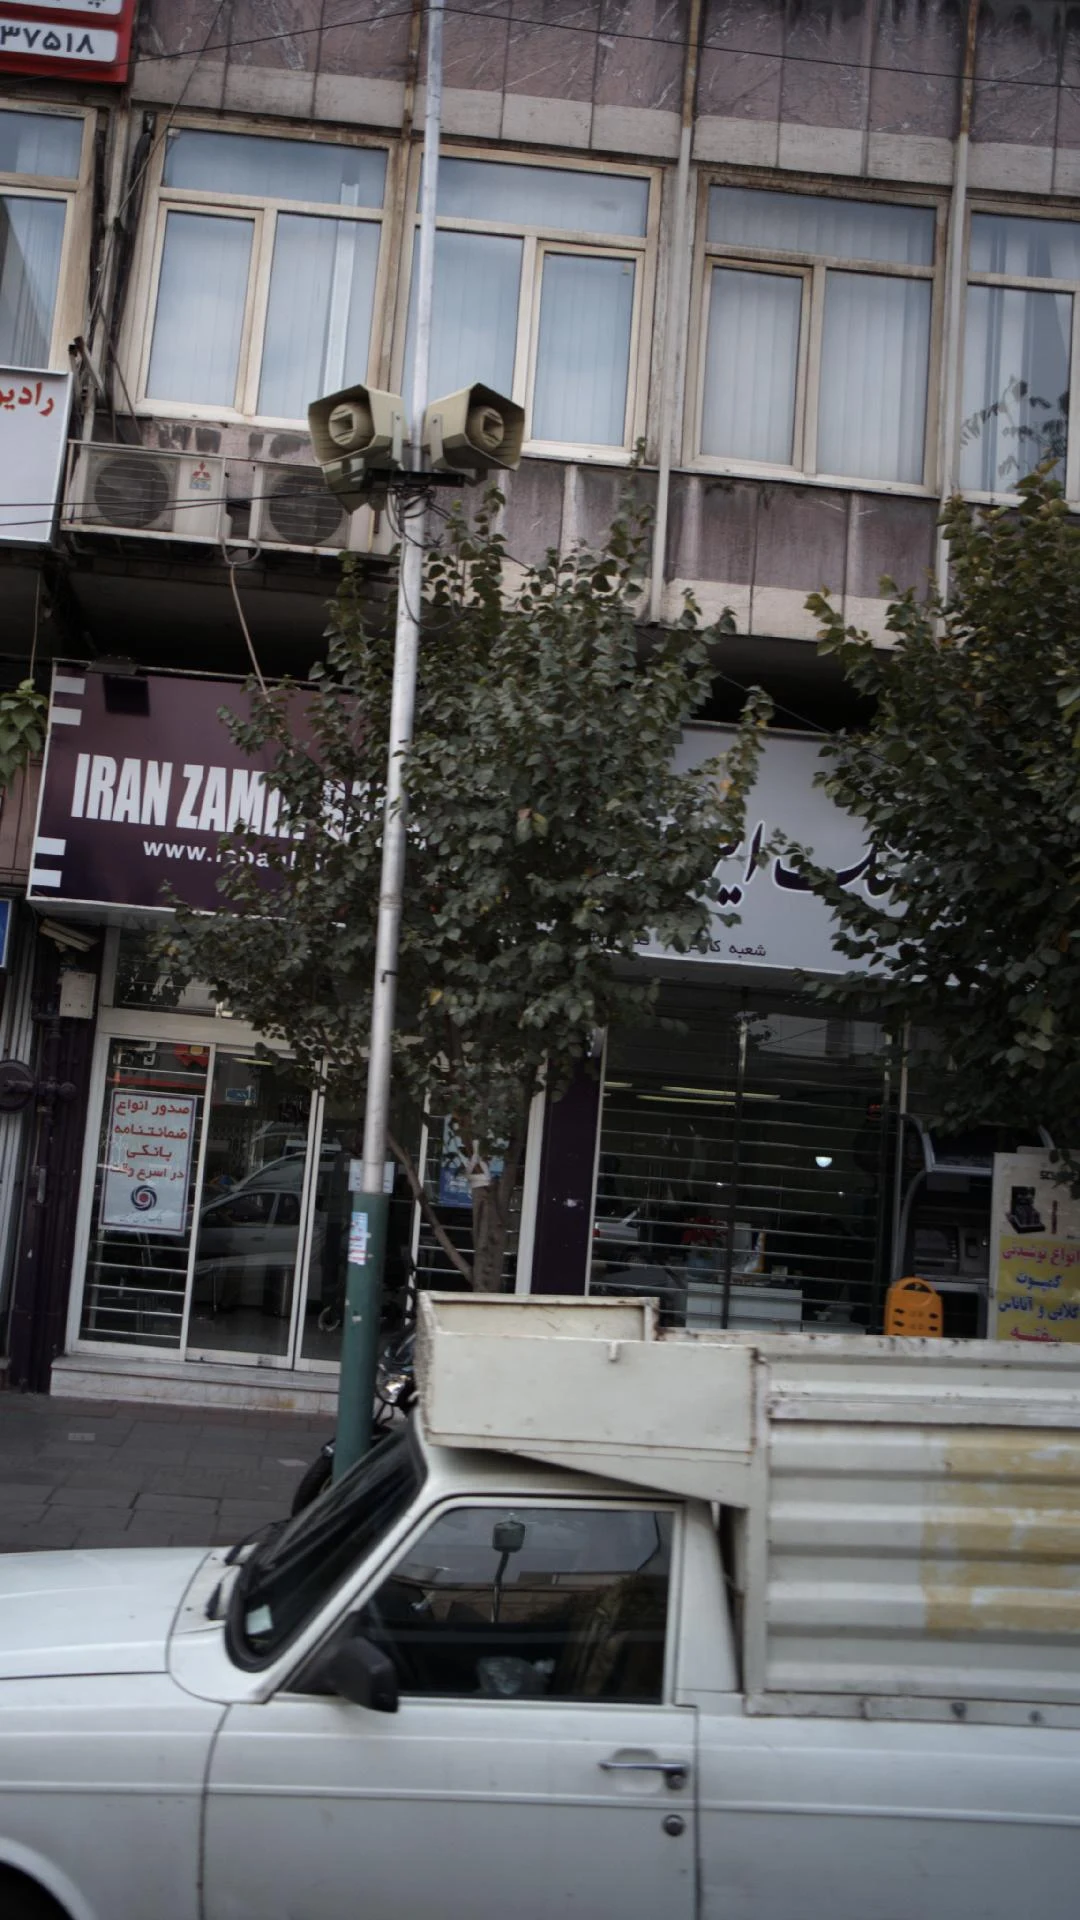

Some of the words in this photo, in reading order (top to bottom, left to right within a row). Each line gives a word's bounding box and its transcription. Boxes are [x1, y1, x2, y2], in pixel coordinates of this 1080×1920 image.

[71, 753, 173, 826] IRAN
[728, 943, 767, 958] شعبه
[115, 1099, 149, 1116] انواع
[152, 1102, 190, 1115] صدور
[114, 1123, 188, 1140] ضمانتنامه
[126, 1144, 173, 1162] بانکی
[136, 1167, 167, 1181] اسرع
[170, 1170, 185, 1181] در
